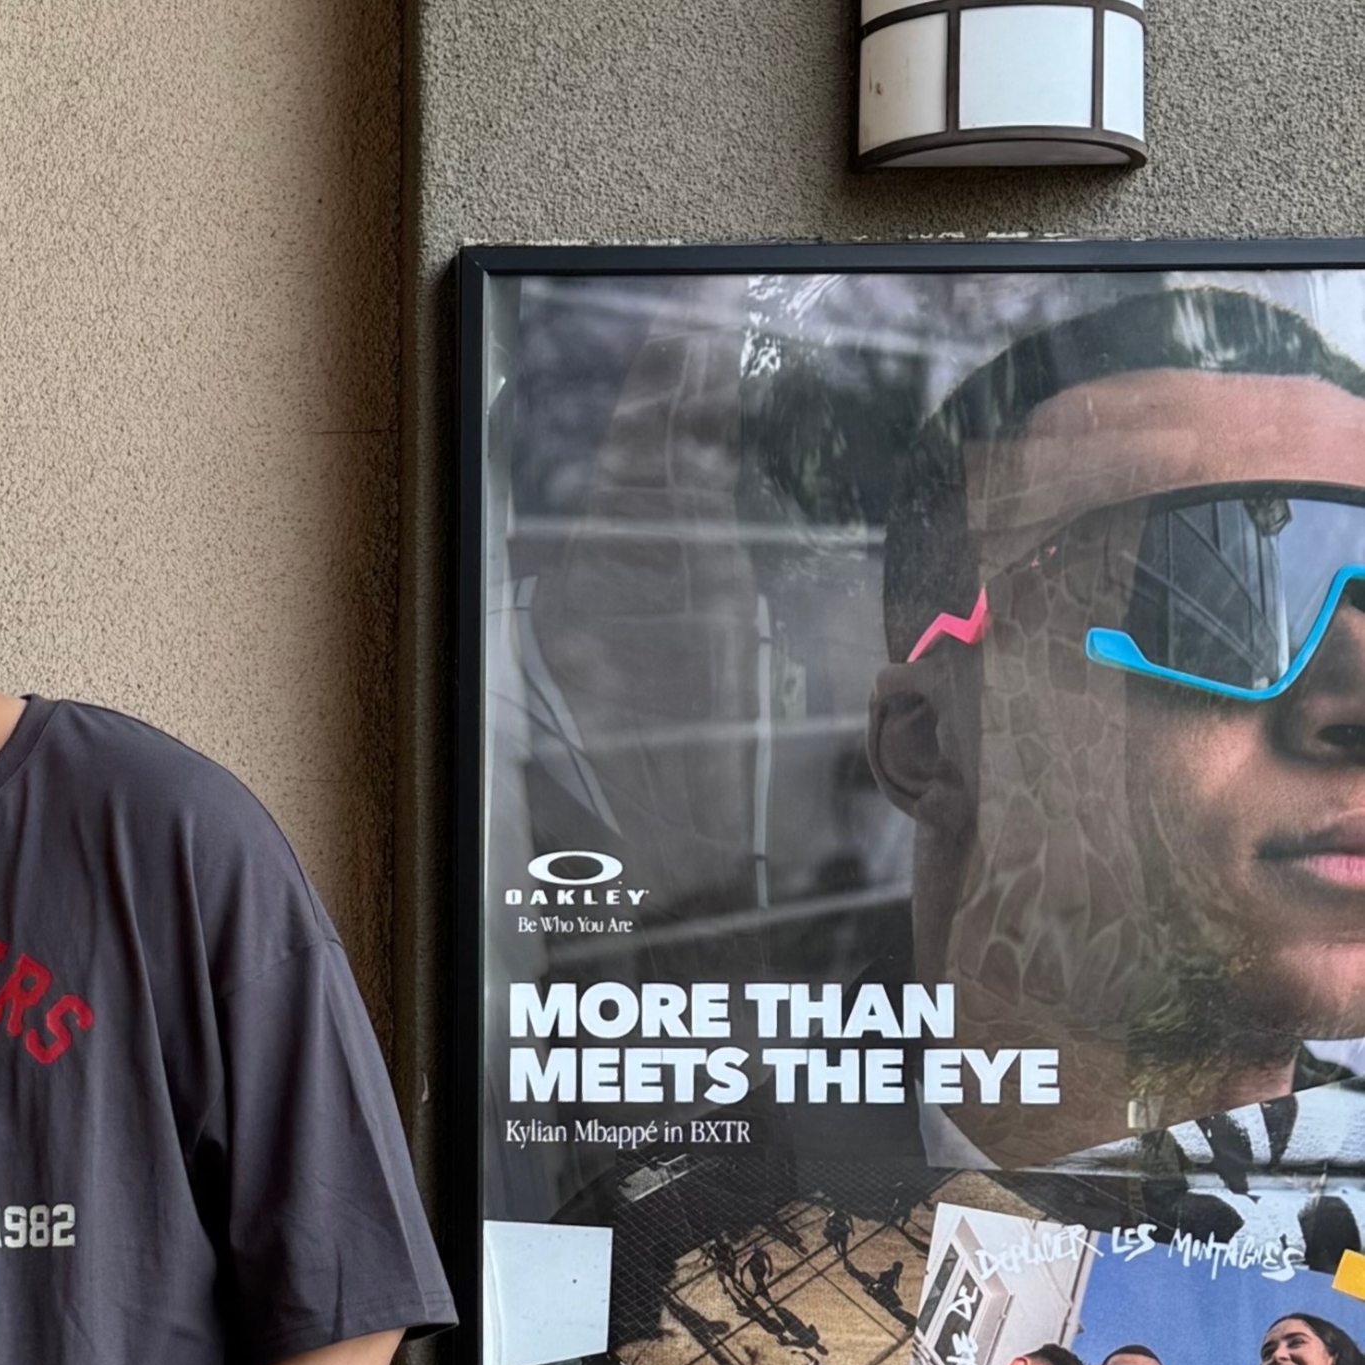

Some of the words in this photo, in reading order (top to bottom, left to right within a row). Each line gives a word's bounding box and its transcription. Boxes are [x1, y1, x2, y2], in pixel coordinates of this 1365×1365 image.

[504, 889, 646, 906] OAKLEY
[517, 915, 538, 934] Be
[540, 915, 575, 934] Who
[576, 916, 605, 934] You
[607, 916, 634, 934] Are
[508, 982, 732, 1039] MORE
[745, 982, 955, 1039] THAN
[508, 1046, 751, 1104] MEETS
[762, 1048, 906, 1104] THE
[923, 1048, 1061, 1104] EYE
[505, 1118, 568, 1150] Kylian
[574, 1118, 659, 1150] Mbappé
[663, 1120, 684, 1143] in
[690, 1120, 752, 1143] BXTR
[1111, 1223, 1158, 1263] LES
